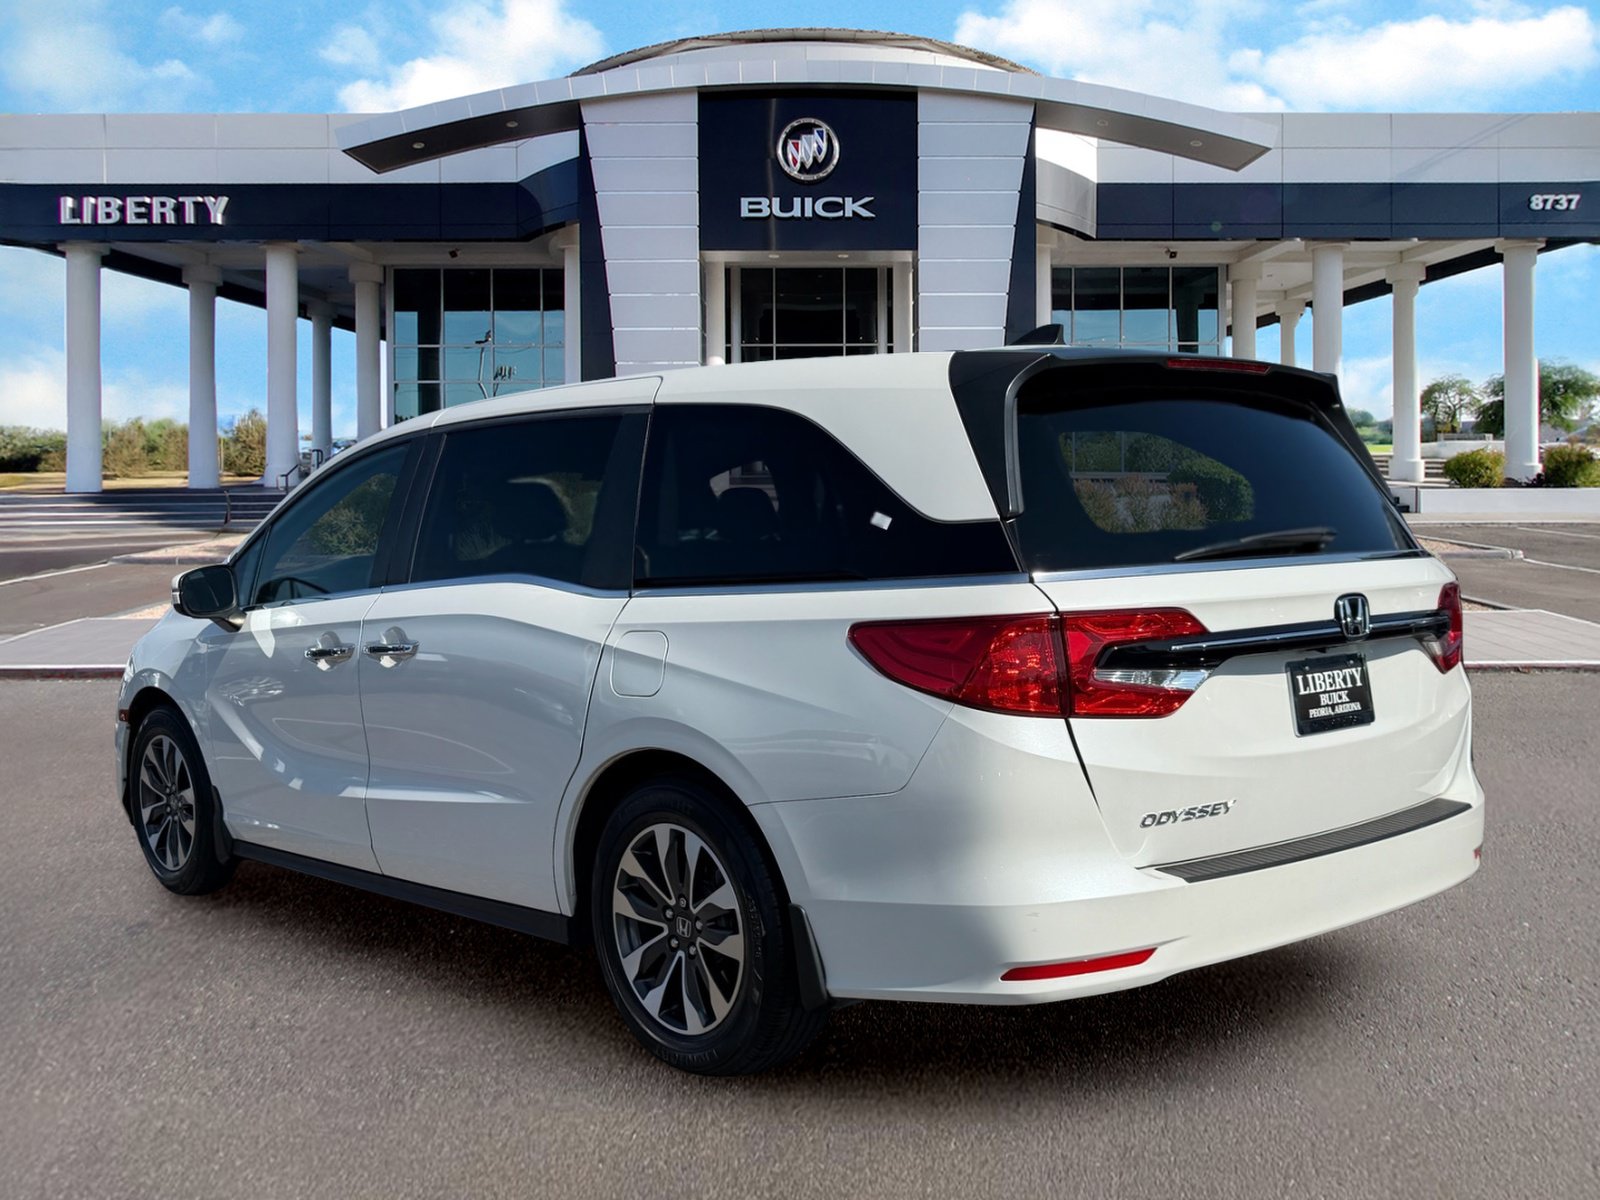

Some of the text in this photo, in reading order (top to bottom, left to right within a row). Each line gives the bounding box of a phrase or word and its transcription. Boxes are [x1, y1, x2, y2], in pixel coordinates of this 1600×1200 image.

[59, 195, 229, 225] LIBERTY
[740, 196, 876, 218] BUICK
[1529, 193, 1581, 211] 8737
[1296, 667, 1363, 695] LIBERTY
[1319, 690, 1350, 706] BUICK
[1139, 799, 1237, 829] ODYSSEY
